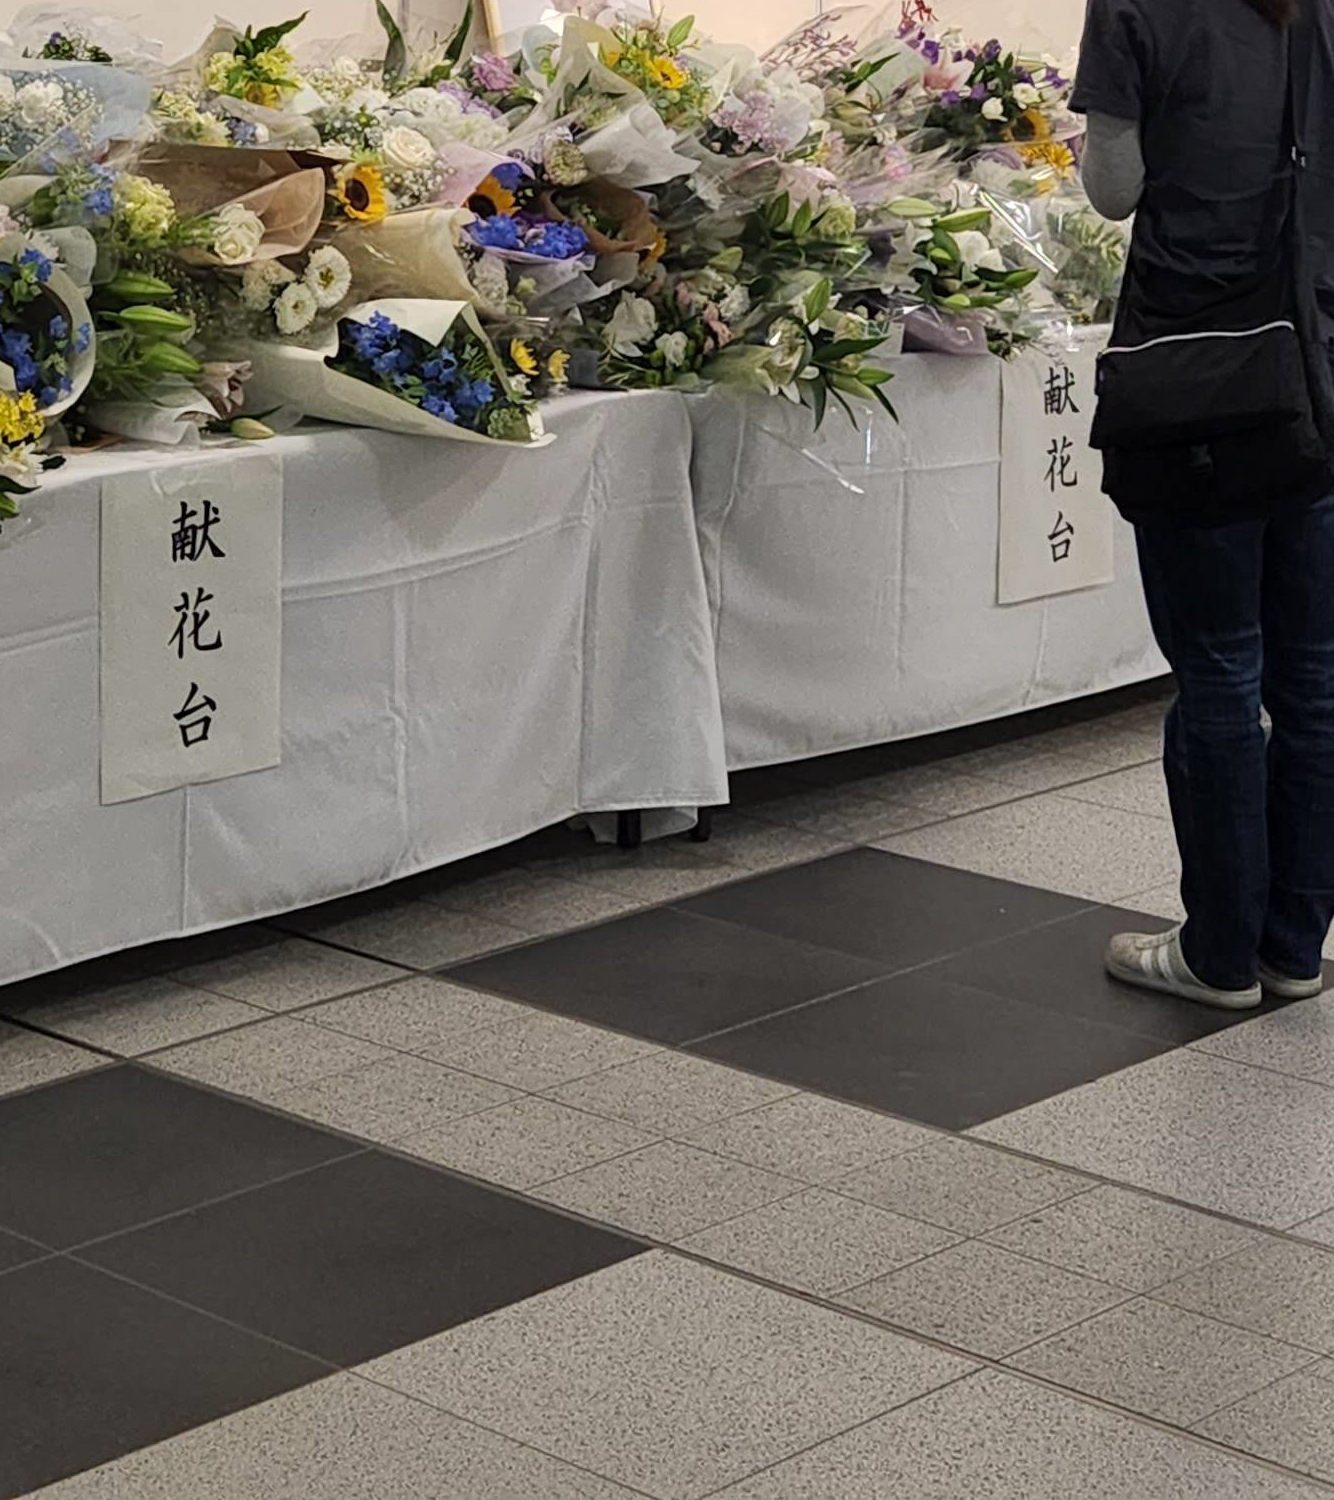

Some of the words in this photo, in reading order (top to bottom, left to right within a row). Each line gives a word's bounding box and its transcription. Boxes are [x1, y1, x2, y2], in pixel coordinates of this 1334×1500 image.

[1043, 366, 1080, 563] 献花台
[168, 500, 226, 748] 献花台
